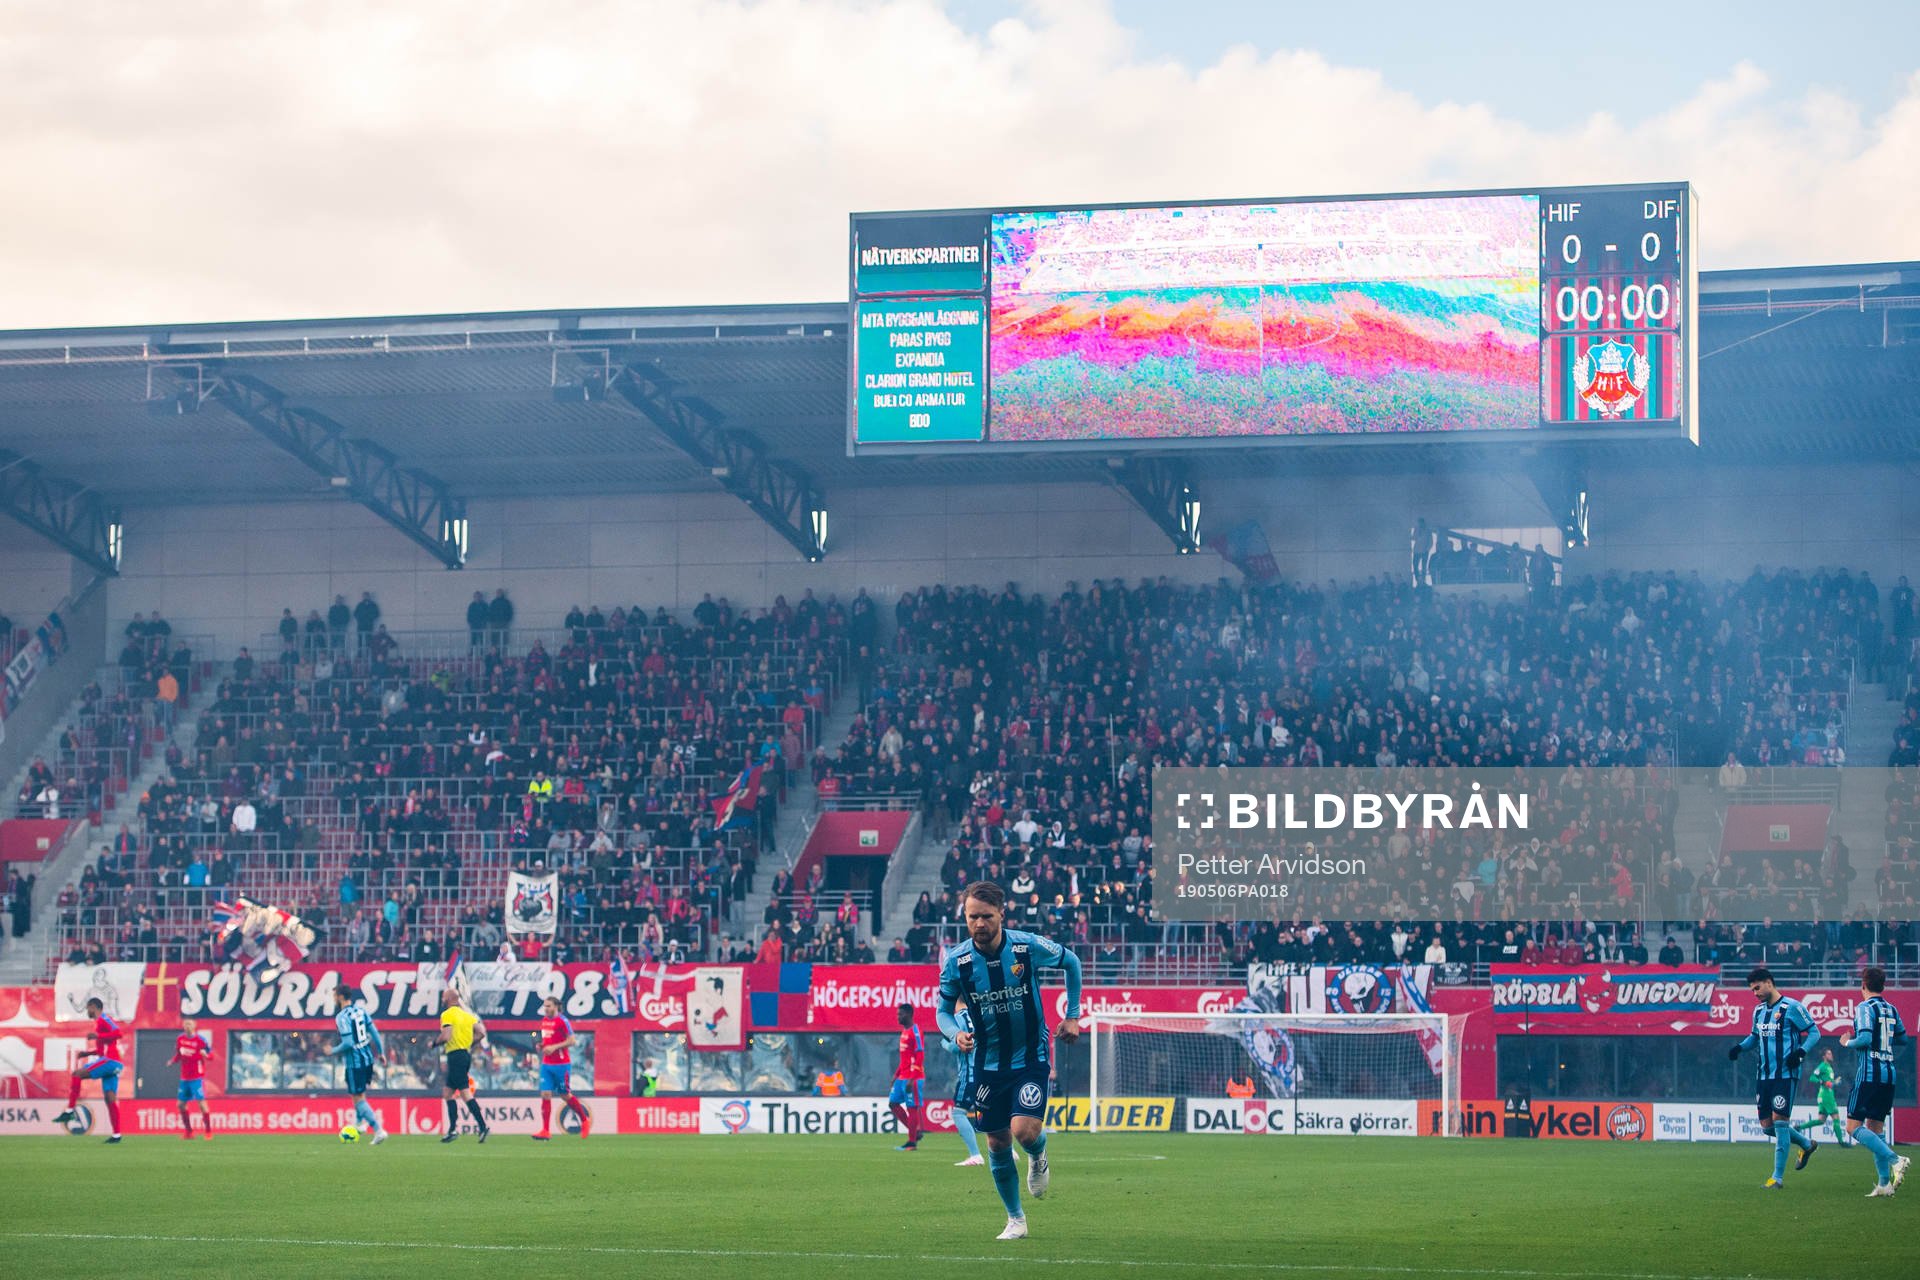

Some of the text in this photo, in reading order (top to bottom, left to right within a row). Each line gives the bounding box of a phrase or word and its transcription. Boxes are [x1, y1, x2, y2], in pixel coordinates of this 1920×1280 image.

[1548, 200, 1677, 222] HIF DIF
[861, 246, 980, 266] NÄTVERKSPARTNER
[1562, 234, 1582, 264] 0
[1641, 232, 1661, 262] 0
[1555, 284, 1669, 322] 00:00
[889, 331, 952, 348] PARAS BYGG
[895, 352, 945, 368] EXPANDIA
[865, 371, 975, 389] CLARION GRAND HOTEL
[915, 393, 966, 407] ARMATUR
[909, 413, 931, 428] BDO
[970, 983, 1029, 1004] Prioritet
[1493, 977, 1716, 1007] RÖDBLÅ UNGDOM
[267, 1108, 334, 1129] sedan
[762, 1103, 899, 1134] Thermia
[1194, 1109, 1284, 1131] DALOC
[1295, 1110, 1413, 1130] Säkra dörrar.
[1529, 1105, 1600, 1137] ykel
[1614, 1111, 1631, 1124] min
[1659, 1115, 1686, 1124] Paras
[1699, 1116, 1726, 1125] Paras
[1616, 1120, 1640, 1137] cykel
[1663, 1124, 1686, 1135] Bygg
[1703, 1124, 1726, 1136] Bygg
